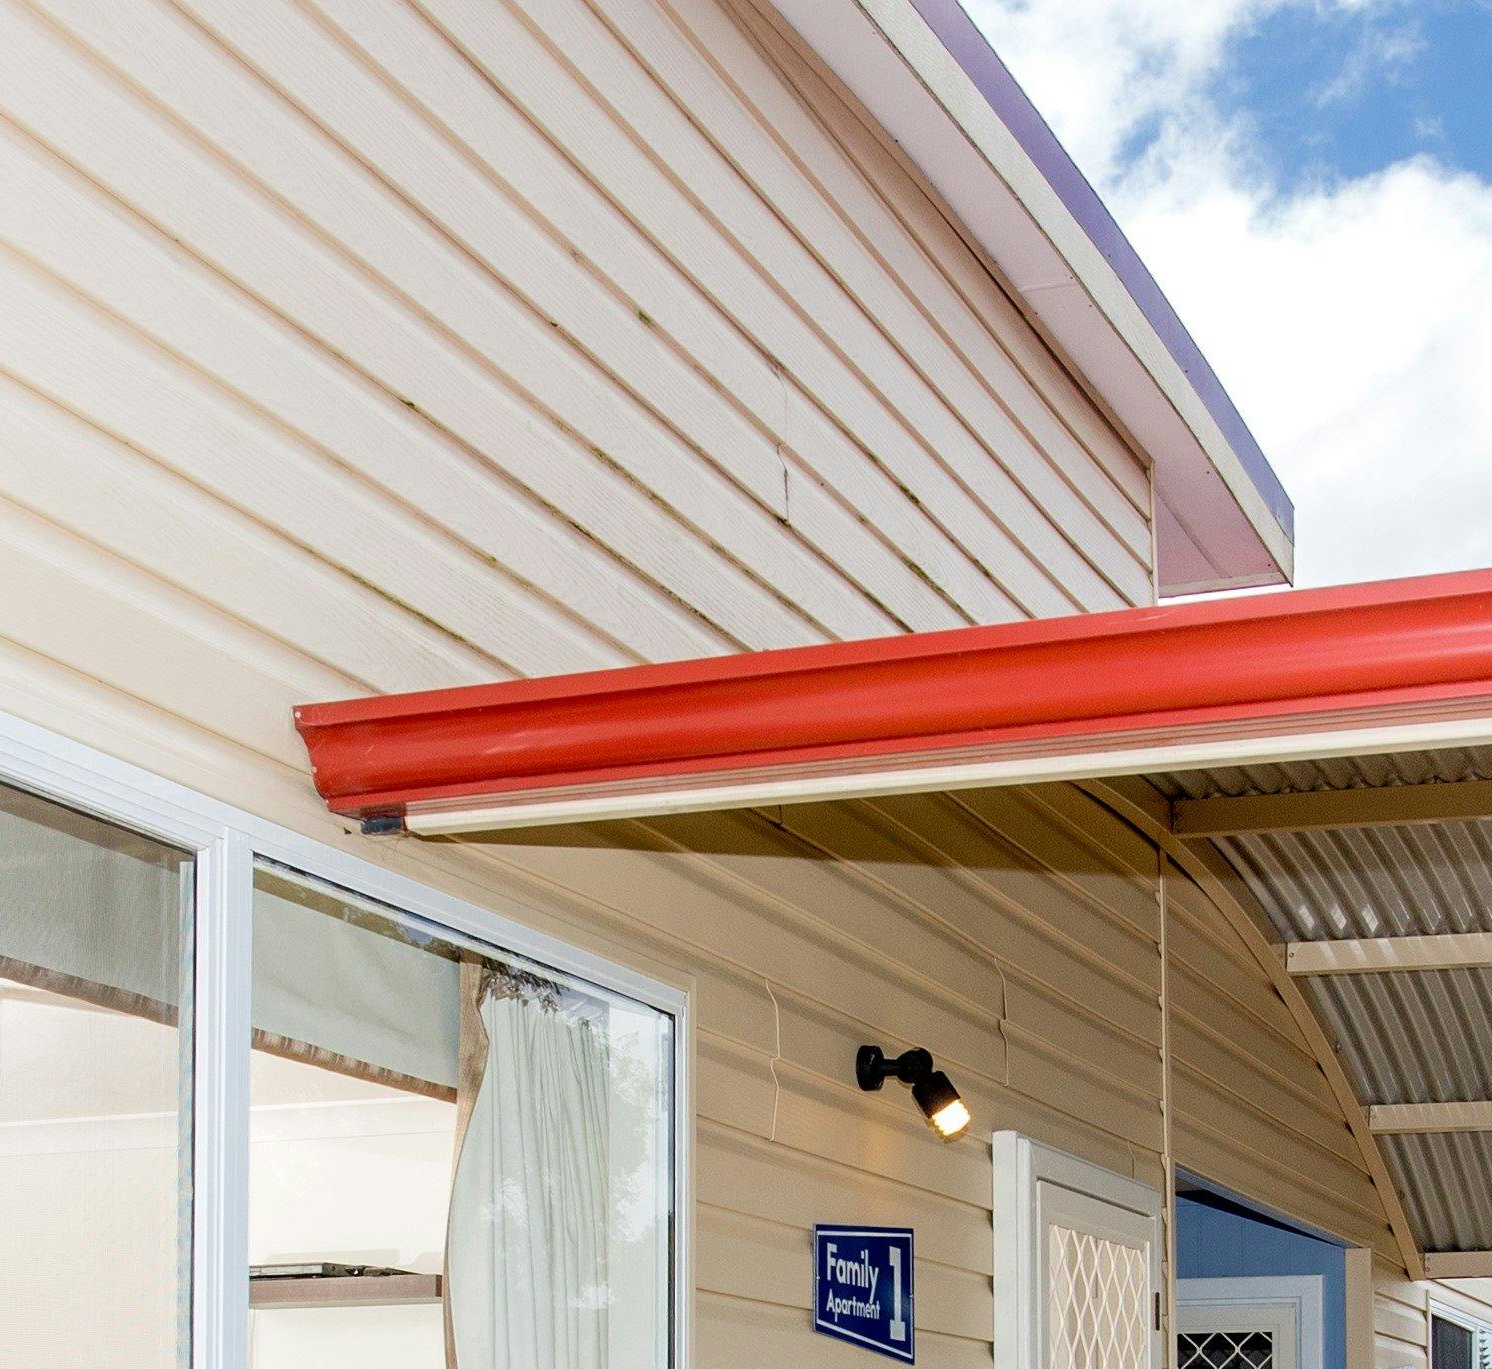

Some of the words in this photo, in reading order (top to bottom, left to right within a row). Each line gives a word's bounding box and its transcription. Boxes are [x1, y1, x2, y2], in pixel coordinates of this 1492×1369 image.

[827, 1242, 879, 1304] Family
[889, 1246, 906, 1342] 1
[826, 1288, 881, 1322] Apartment
